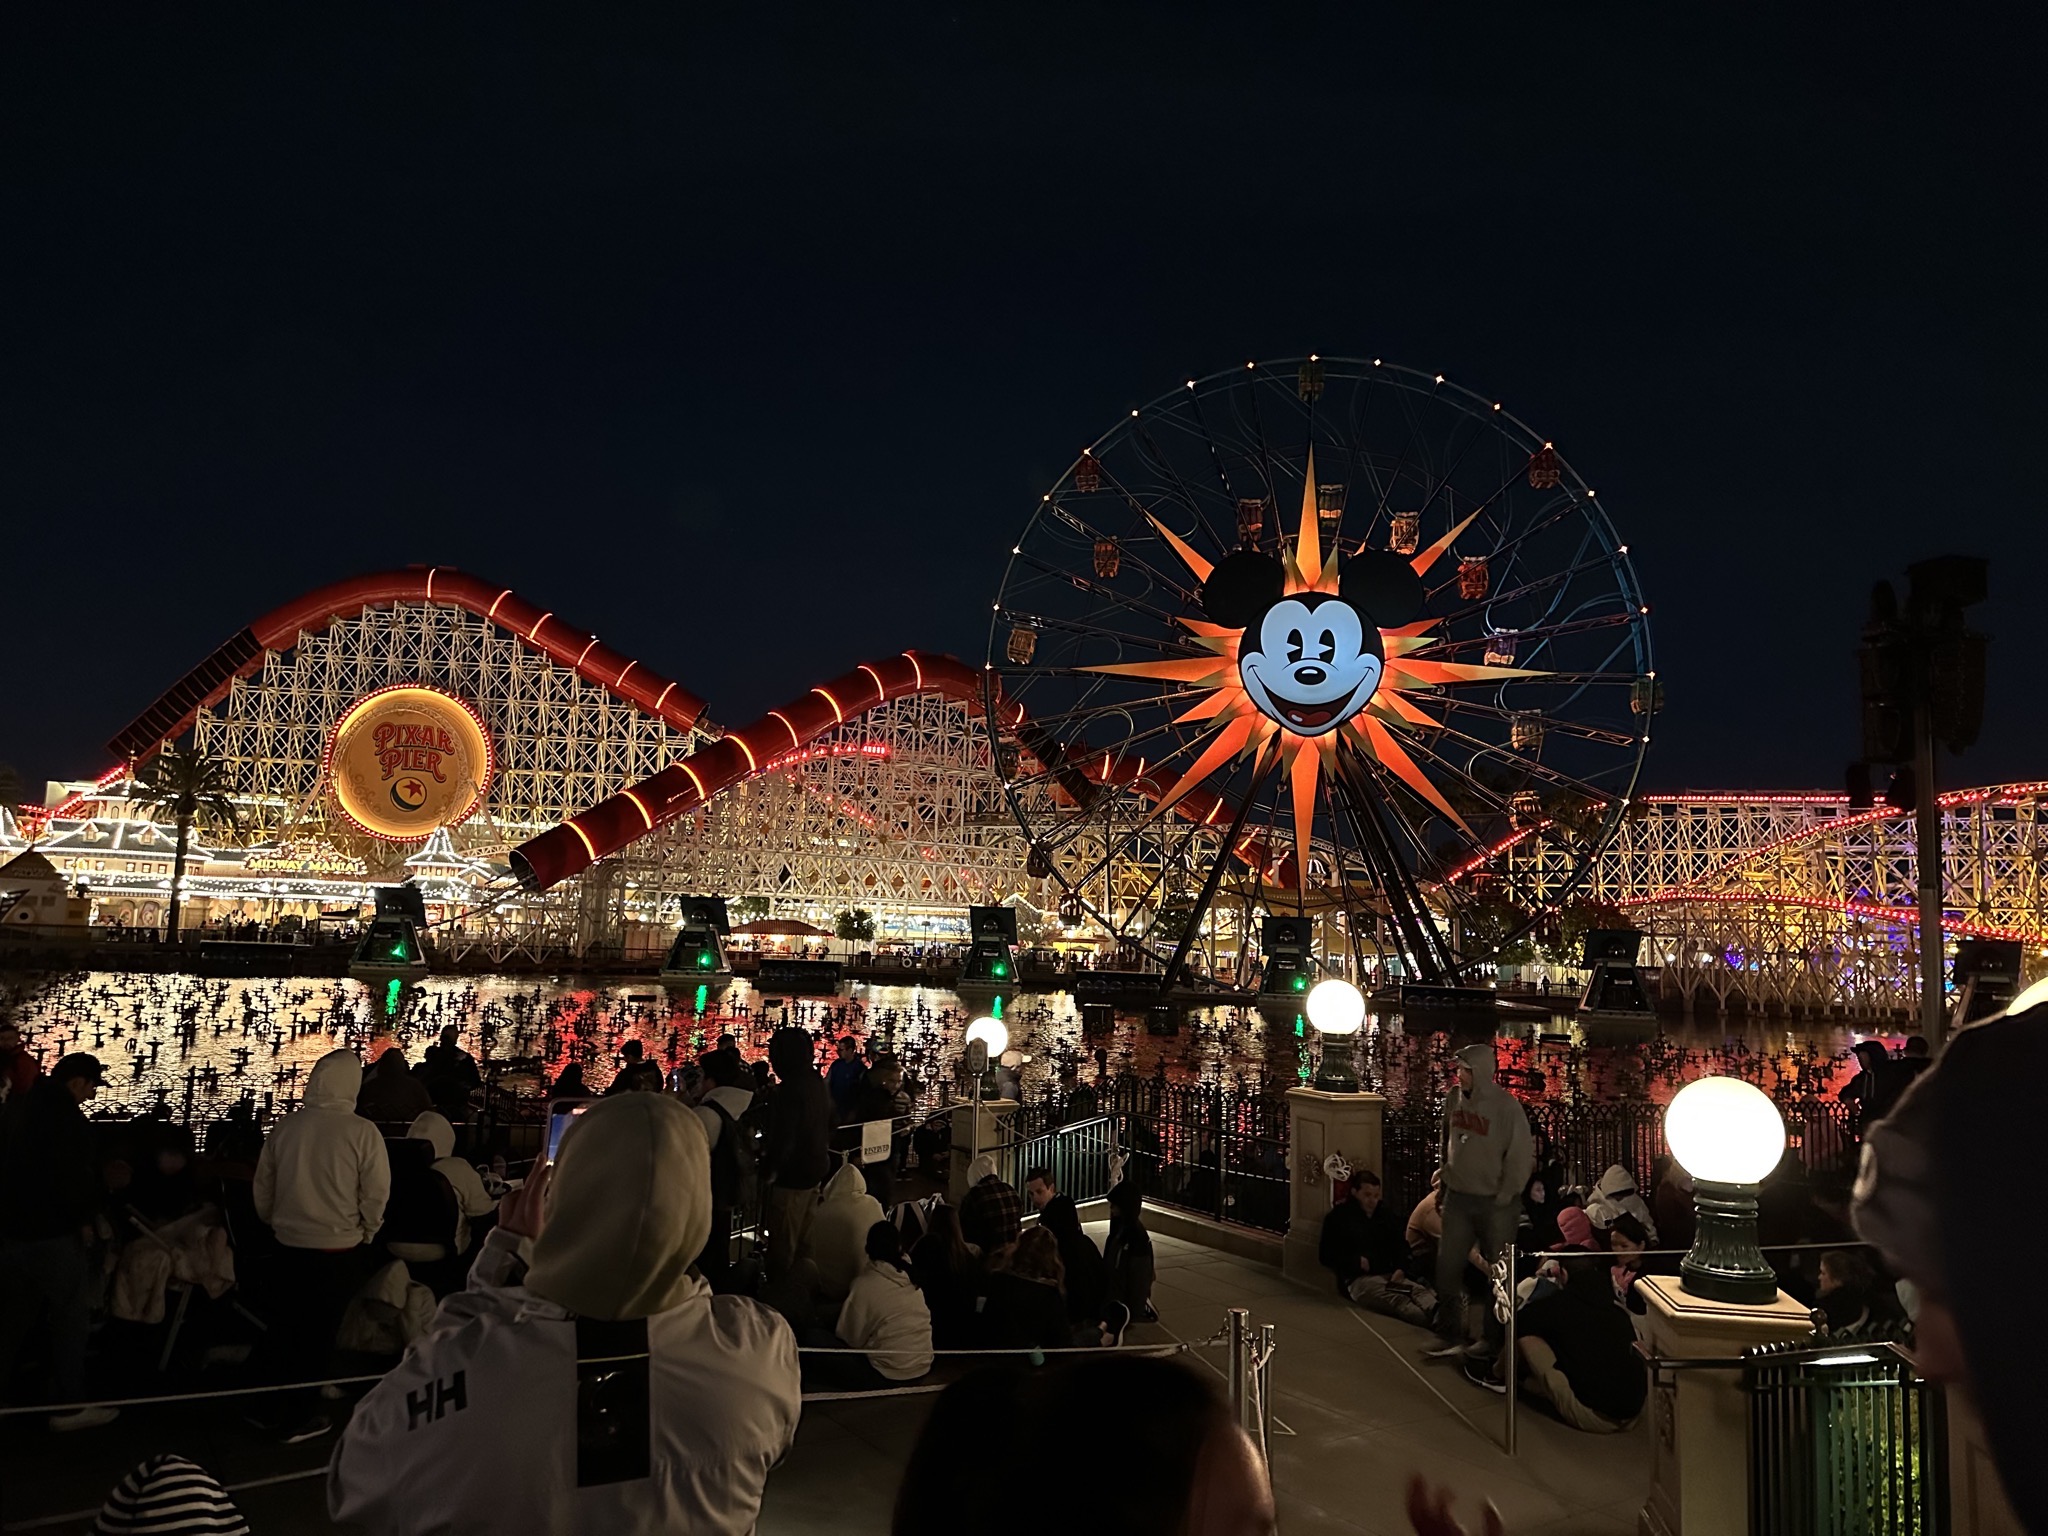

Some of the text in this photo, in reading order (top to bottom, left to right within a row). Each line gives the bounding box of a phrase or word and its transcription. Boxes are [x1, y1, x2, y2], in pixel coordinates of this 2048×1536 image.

[372, 721, 455, 756] PIXAR
[379, 748, 447, 783] PIER
[248, 859, 359, 872] MIDWAY MANIA!
[864, 1144, 890, 1156] RESERVED
[406, 1370, 468, 1432] HH
